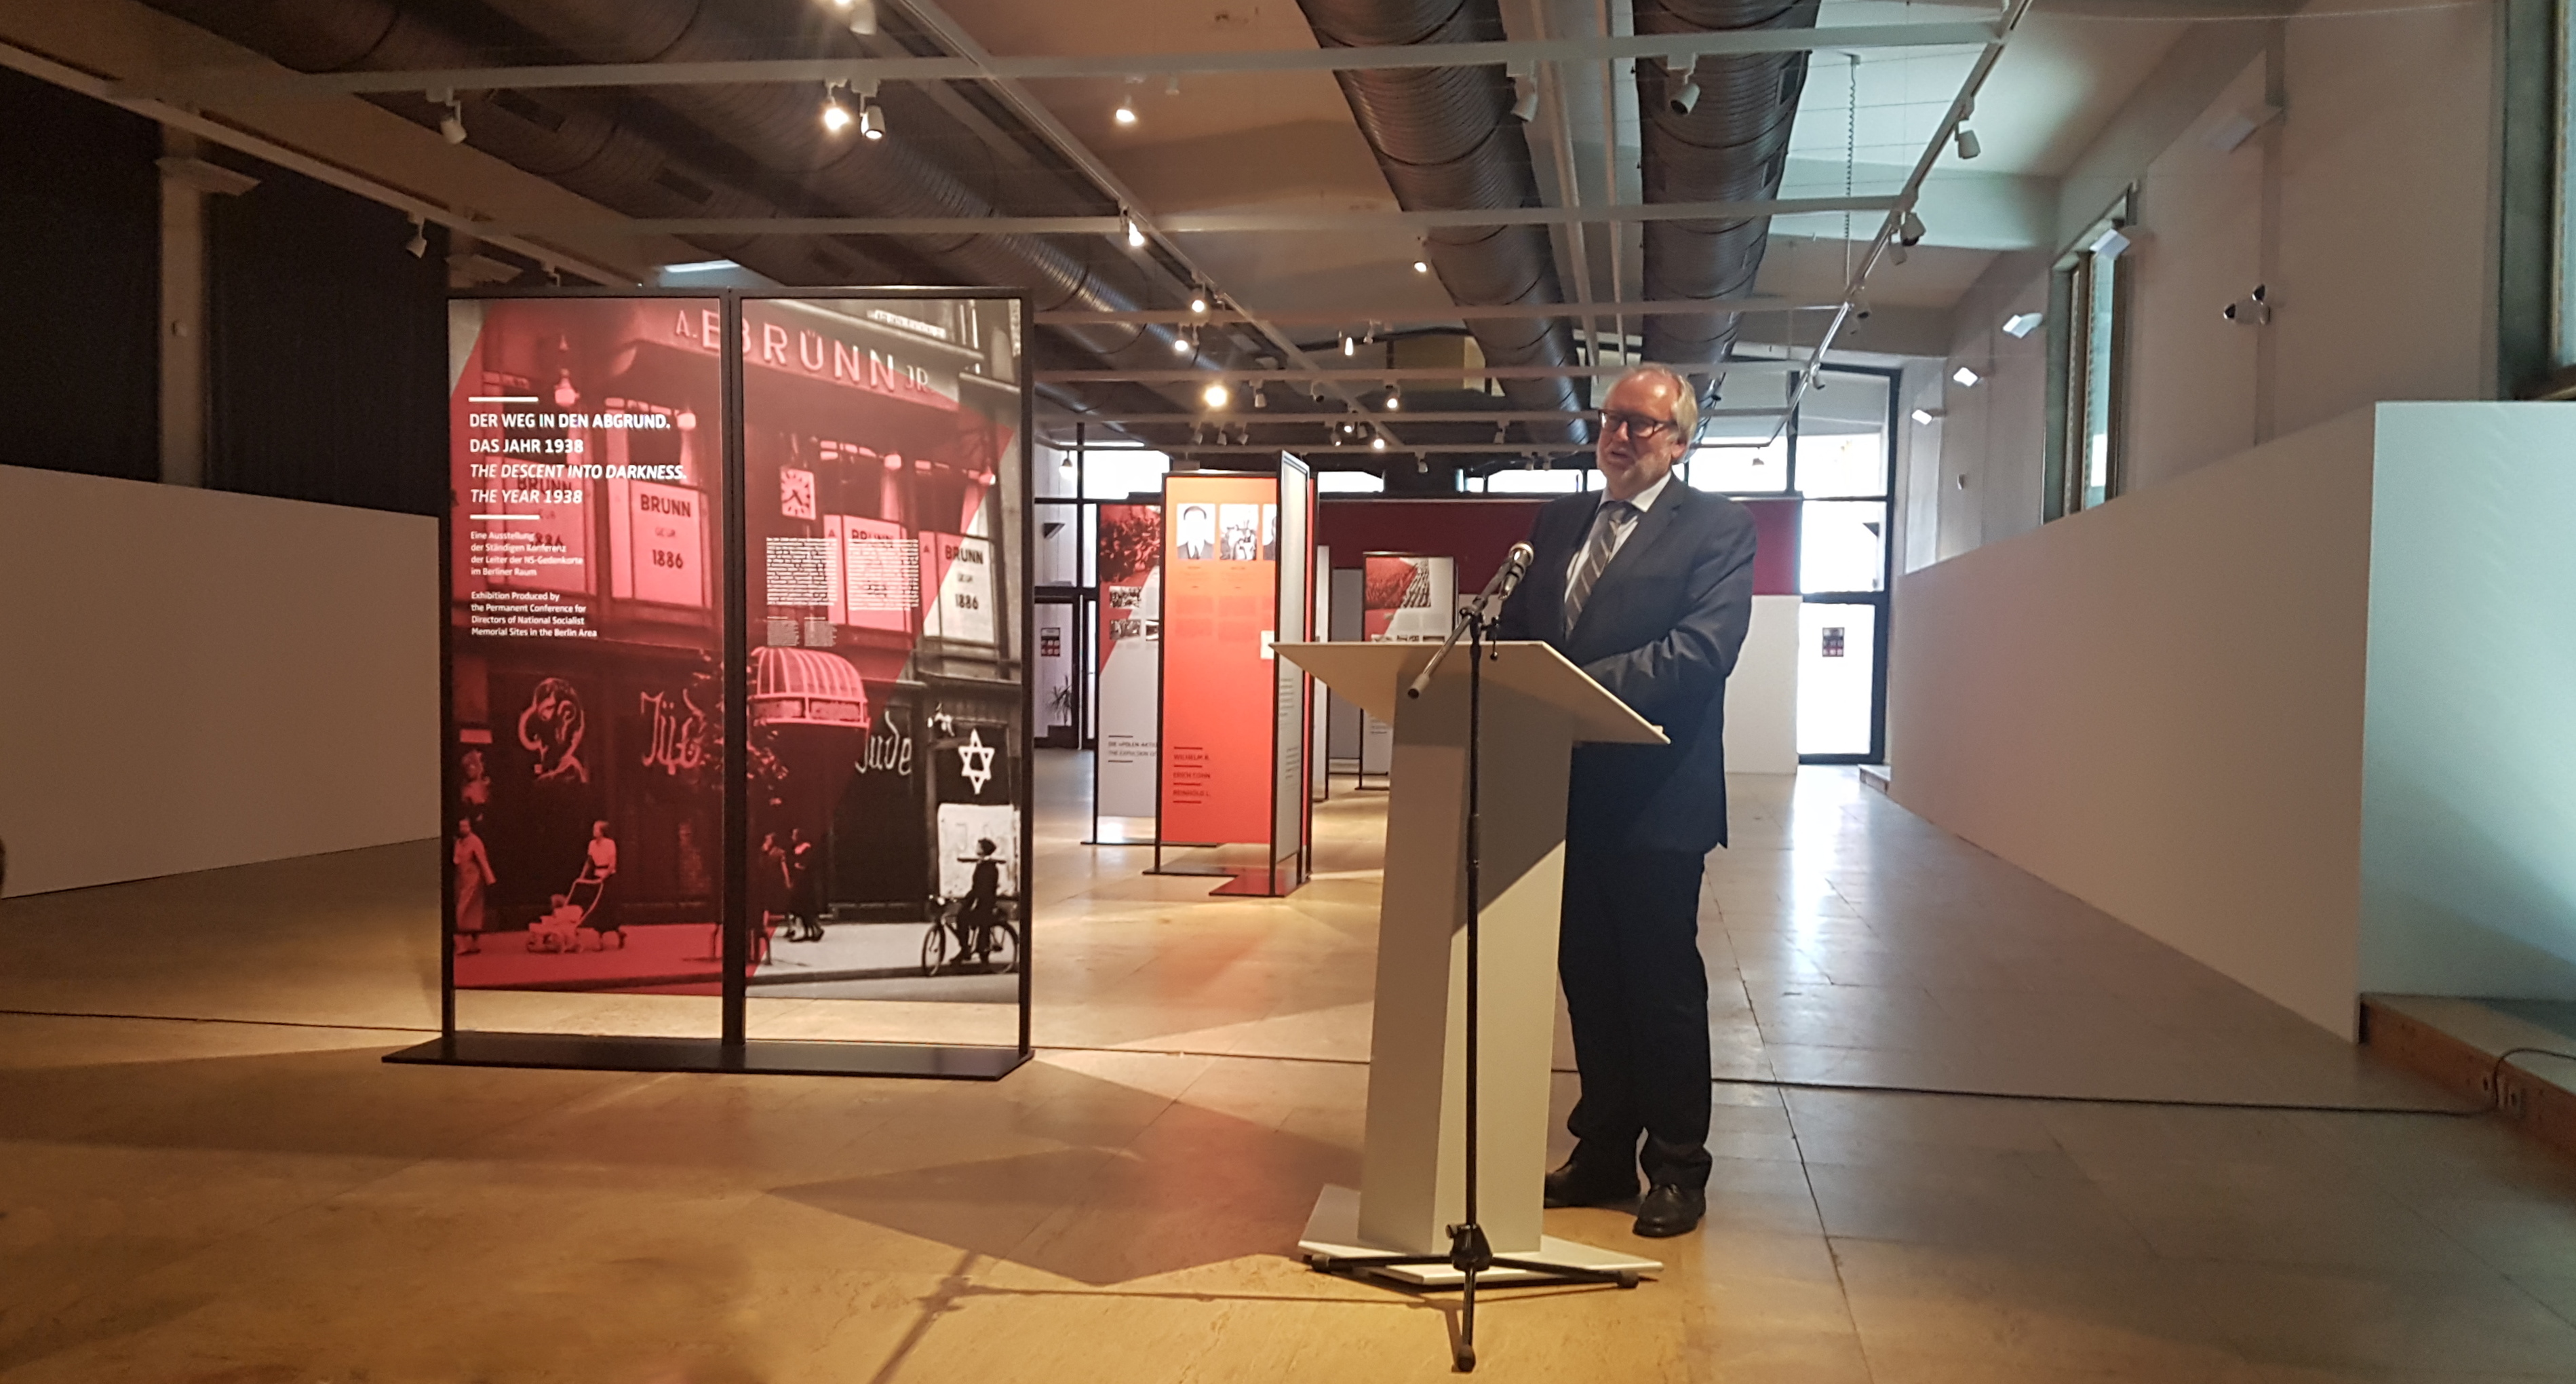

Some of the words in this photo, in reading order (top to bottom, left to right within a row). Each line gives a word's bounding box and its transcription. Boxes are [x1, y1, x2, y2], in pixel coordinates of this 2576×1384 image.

[469, 413, 498, 428] DER
[501, 413, 535, 428] WEG
[539, 414, 555, 428] IN
[558, 414, 589, 428] DEN
[591, 414, 671, 429] ABGRUND.
[469, 439, 499, 453] DAS
[503, 439, 541, 453] JAHR
[545, 439, 583, 453] 1938
[471, 463, 498, 478] THE
[500, 463, 566, 478] DESCENT
[568, 464, 602, 478] INTO
[606, 465, 687, 480] DARKNESS.
[471, 489, 497, 503] THE
[502, 489, 540, 503] YEAR
[545, 489, 583, 503] 1938
[640, 493, 690, 518] BRUNN
[470, 531, 488, 539] Eine
[488, 532, 535, 542] Ausstellung
[471, 543, 484, 552] der
[485, 543, 526, 554] Ständigen
[526, 543, 567, 553] Konferenz
[945, 544, 983, 565] BRUNN
[486, 556, 508, 564] Leiter
[509, 556, 522, 564] der
[652, 549, 684, 569] 1886
[482, 567, 513, 576] Berliner
[513, 567, 538, 576] Raum
[471, 591, 510, 600] Exhibition
[511, 592, 549, 600] Produced
[549, 592, 560, 602] by
[955, 593, 979, 610] 1886
[471, 603, 484, 611] the
[486, 604, 528, 612] Permanent
[530, 604, 573, 613] Conference
[574, 604, 587, 613] for
[471, 615, 506, 623] Directors
[507, 615, 516, 623] of
[517, 615, 551, 624] National
[552, 616, 585, 625] Socialist
[471, 628, 507, 636] Memorial
[509, 628, 528, 636] Sites
[530, 628, 537, 636] in
[539, 628, 553, 636] the
[554, 628, 577, 636] Berlin
[578, 628, 598, 637] Area
